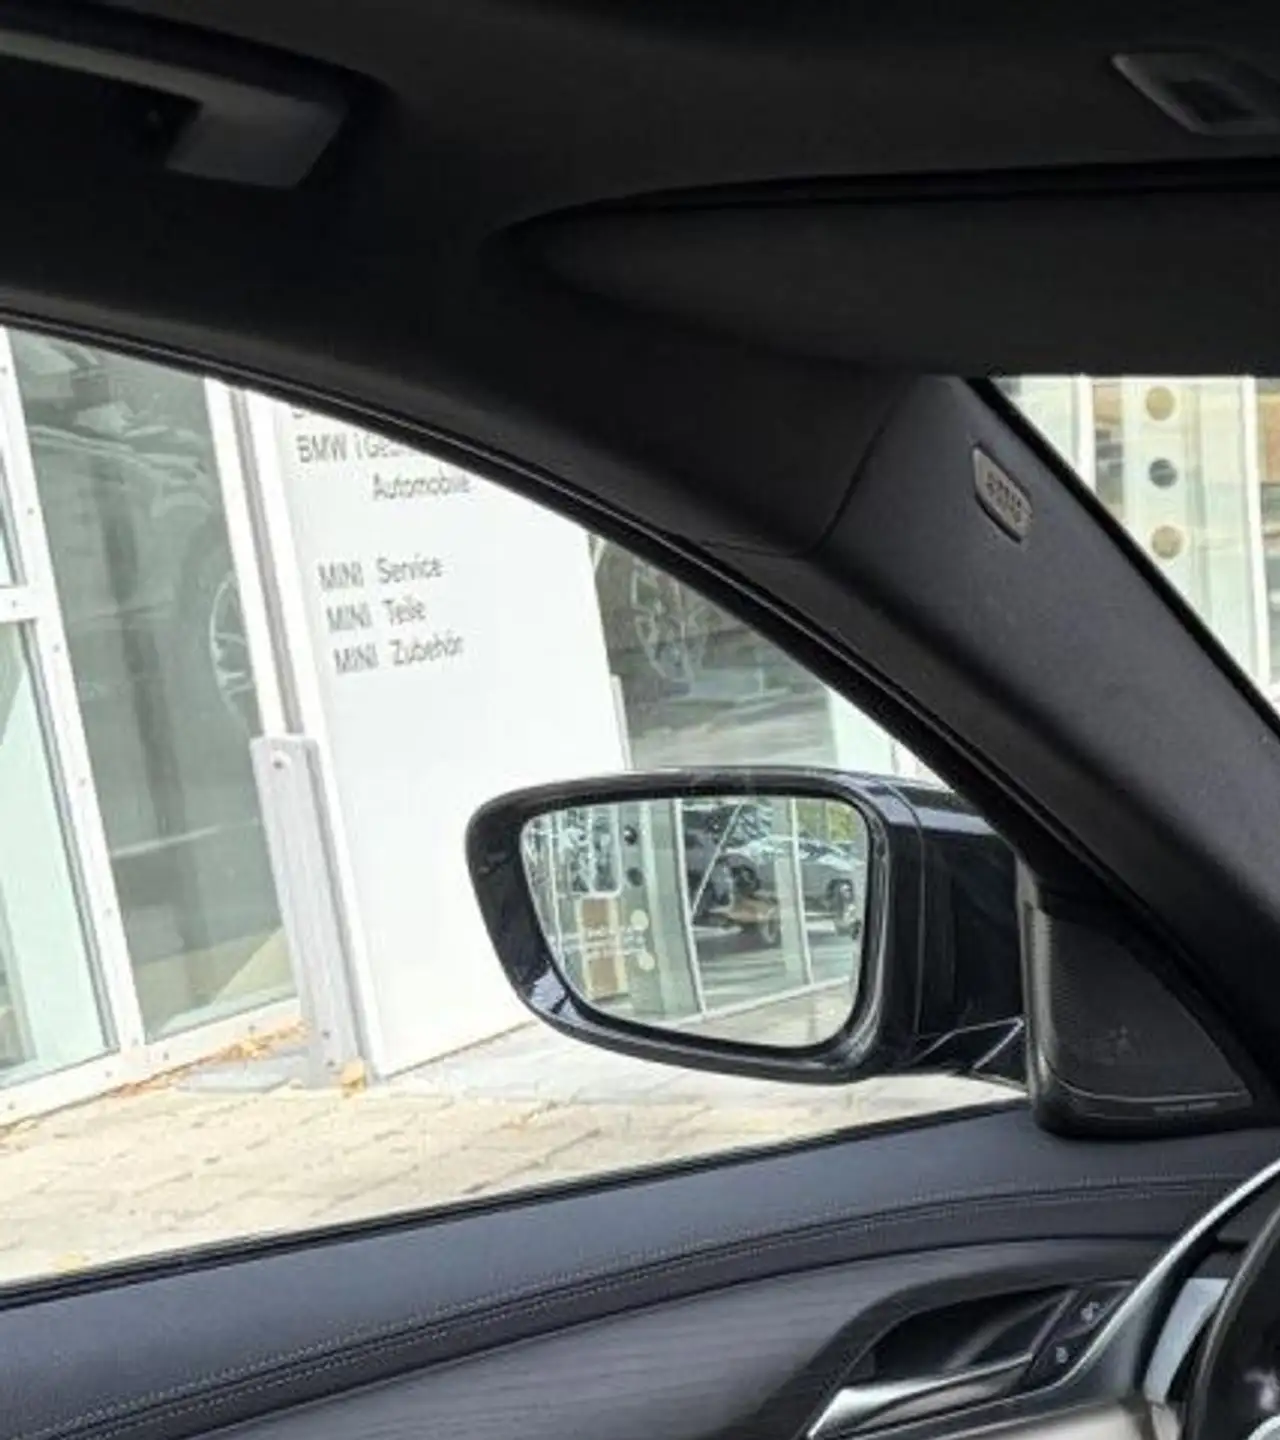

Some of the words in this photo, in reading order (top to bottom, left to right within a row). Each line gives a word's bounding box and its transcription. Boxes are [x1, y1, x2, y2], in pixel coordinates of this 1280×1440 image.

[317, 560, 364, 589] MINI
[375, 555, 444, 584] Service
[326, 602, 373, 632] MINI
[381, 596, 426, 626] Teile
[334, 643, 379, 674] MINI
[388, 632, 464, 666] Zubehör
